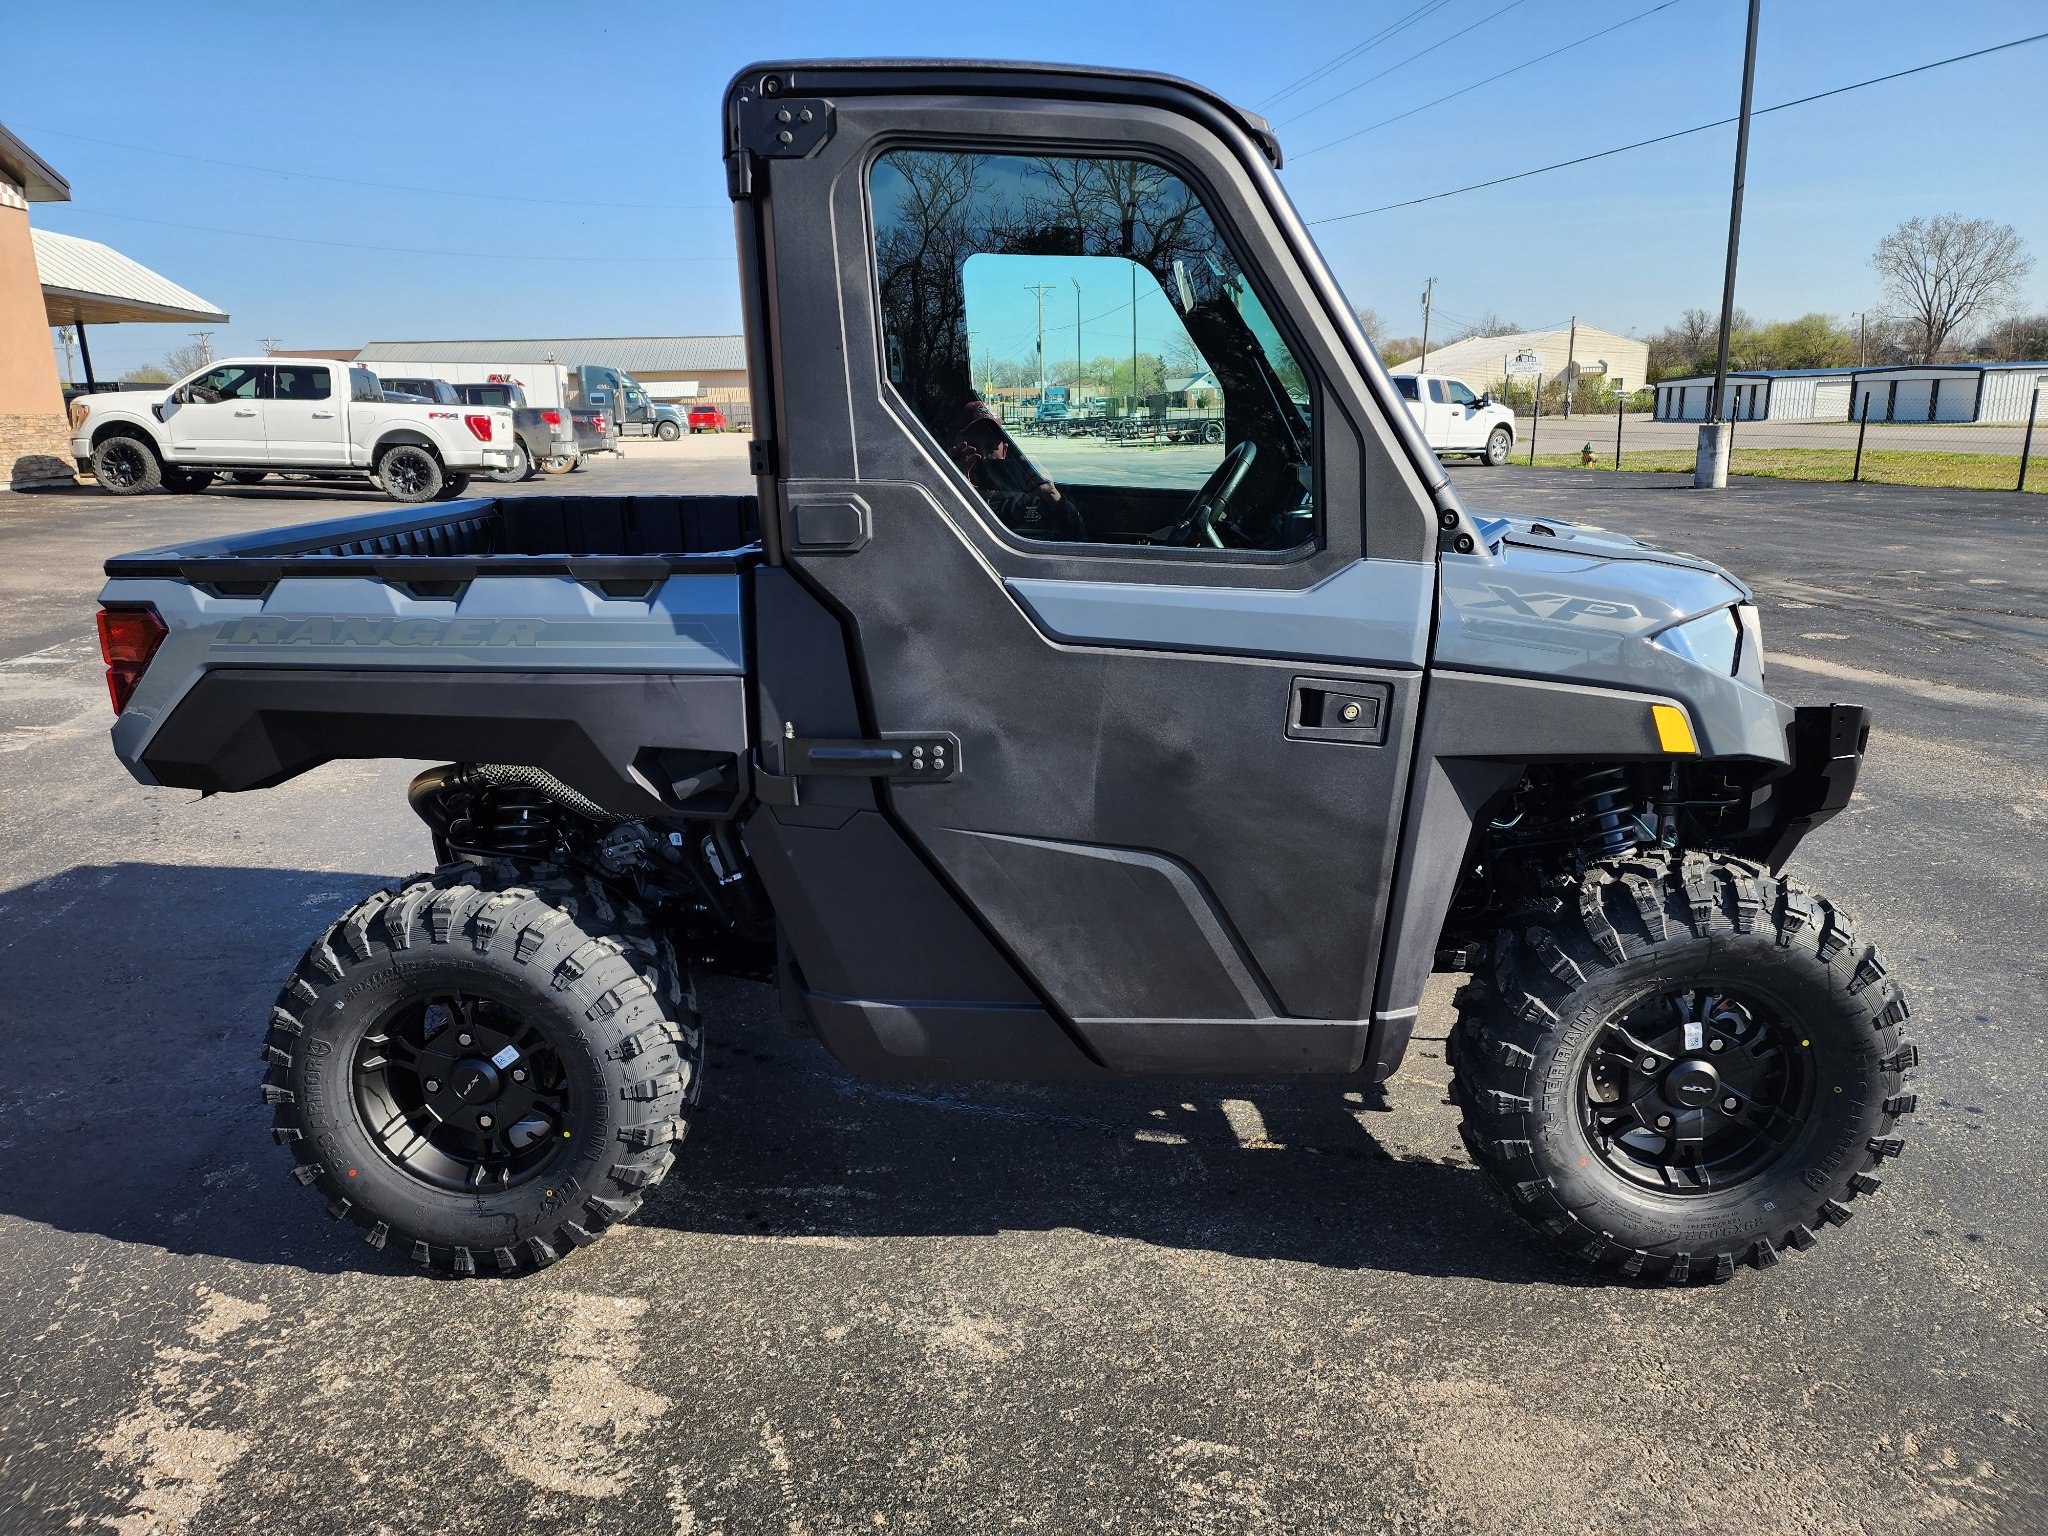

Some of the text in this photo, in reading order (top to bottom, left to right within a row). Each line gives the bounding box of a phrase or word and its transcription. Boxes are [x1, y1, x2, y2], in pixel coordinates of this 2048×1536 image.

[428, 411, 459, 421] FX4
[1459, 581, 1643, 623] XP
[227, 615, 548, 647] RANGER
[304, 1058, 330, 1130] ARMOR
[1541, 1004, 1601, 1142] X-TERRAIN
